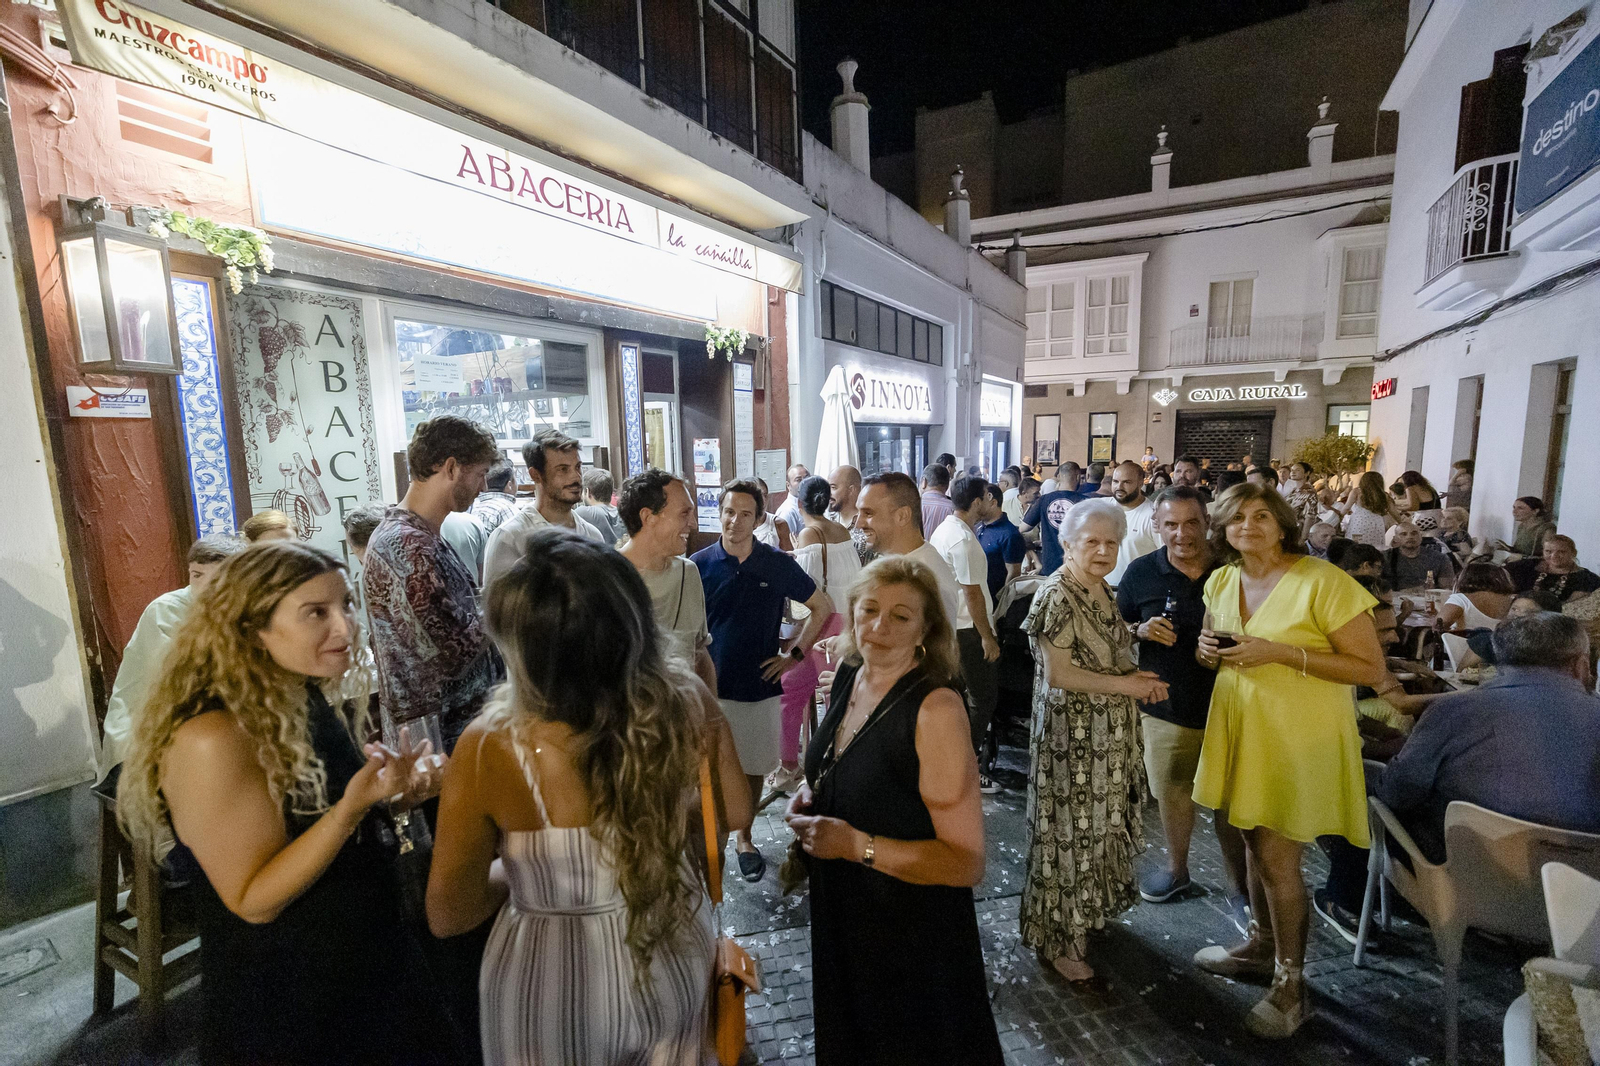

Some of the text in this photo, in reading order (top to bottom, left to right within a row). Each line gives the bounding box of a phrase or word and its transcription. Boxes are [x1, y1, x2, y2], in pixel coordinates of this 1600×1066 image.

[94, 0, 267, 83] Cruzcampo
[94, 28, 277, 102] MAESTROS CERVECEROS
[182, 74, 216, 92] 1904
[456, 144, 634, 233] ABACERIA
[666, 223, 753, 270] la cañailla
[870, 378, 932, 412] INNOVA
[1190, 384, 1307, 402] CAJA RURAL
